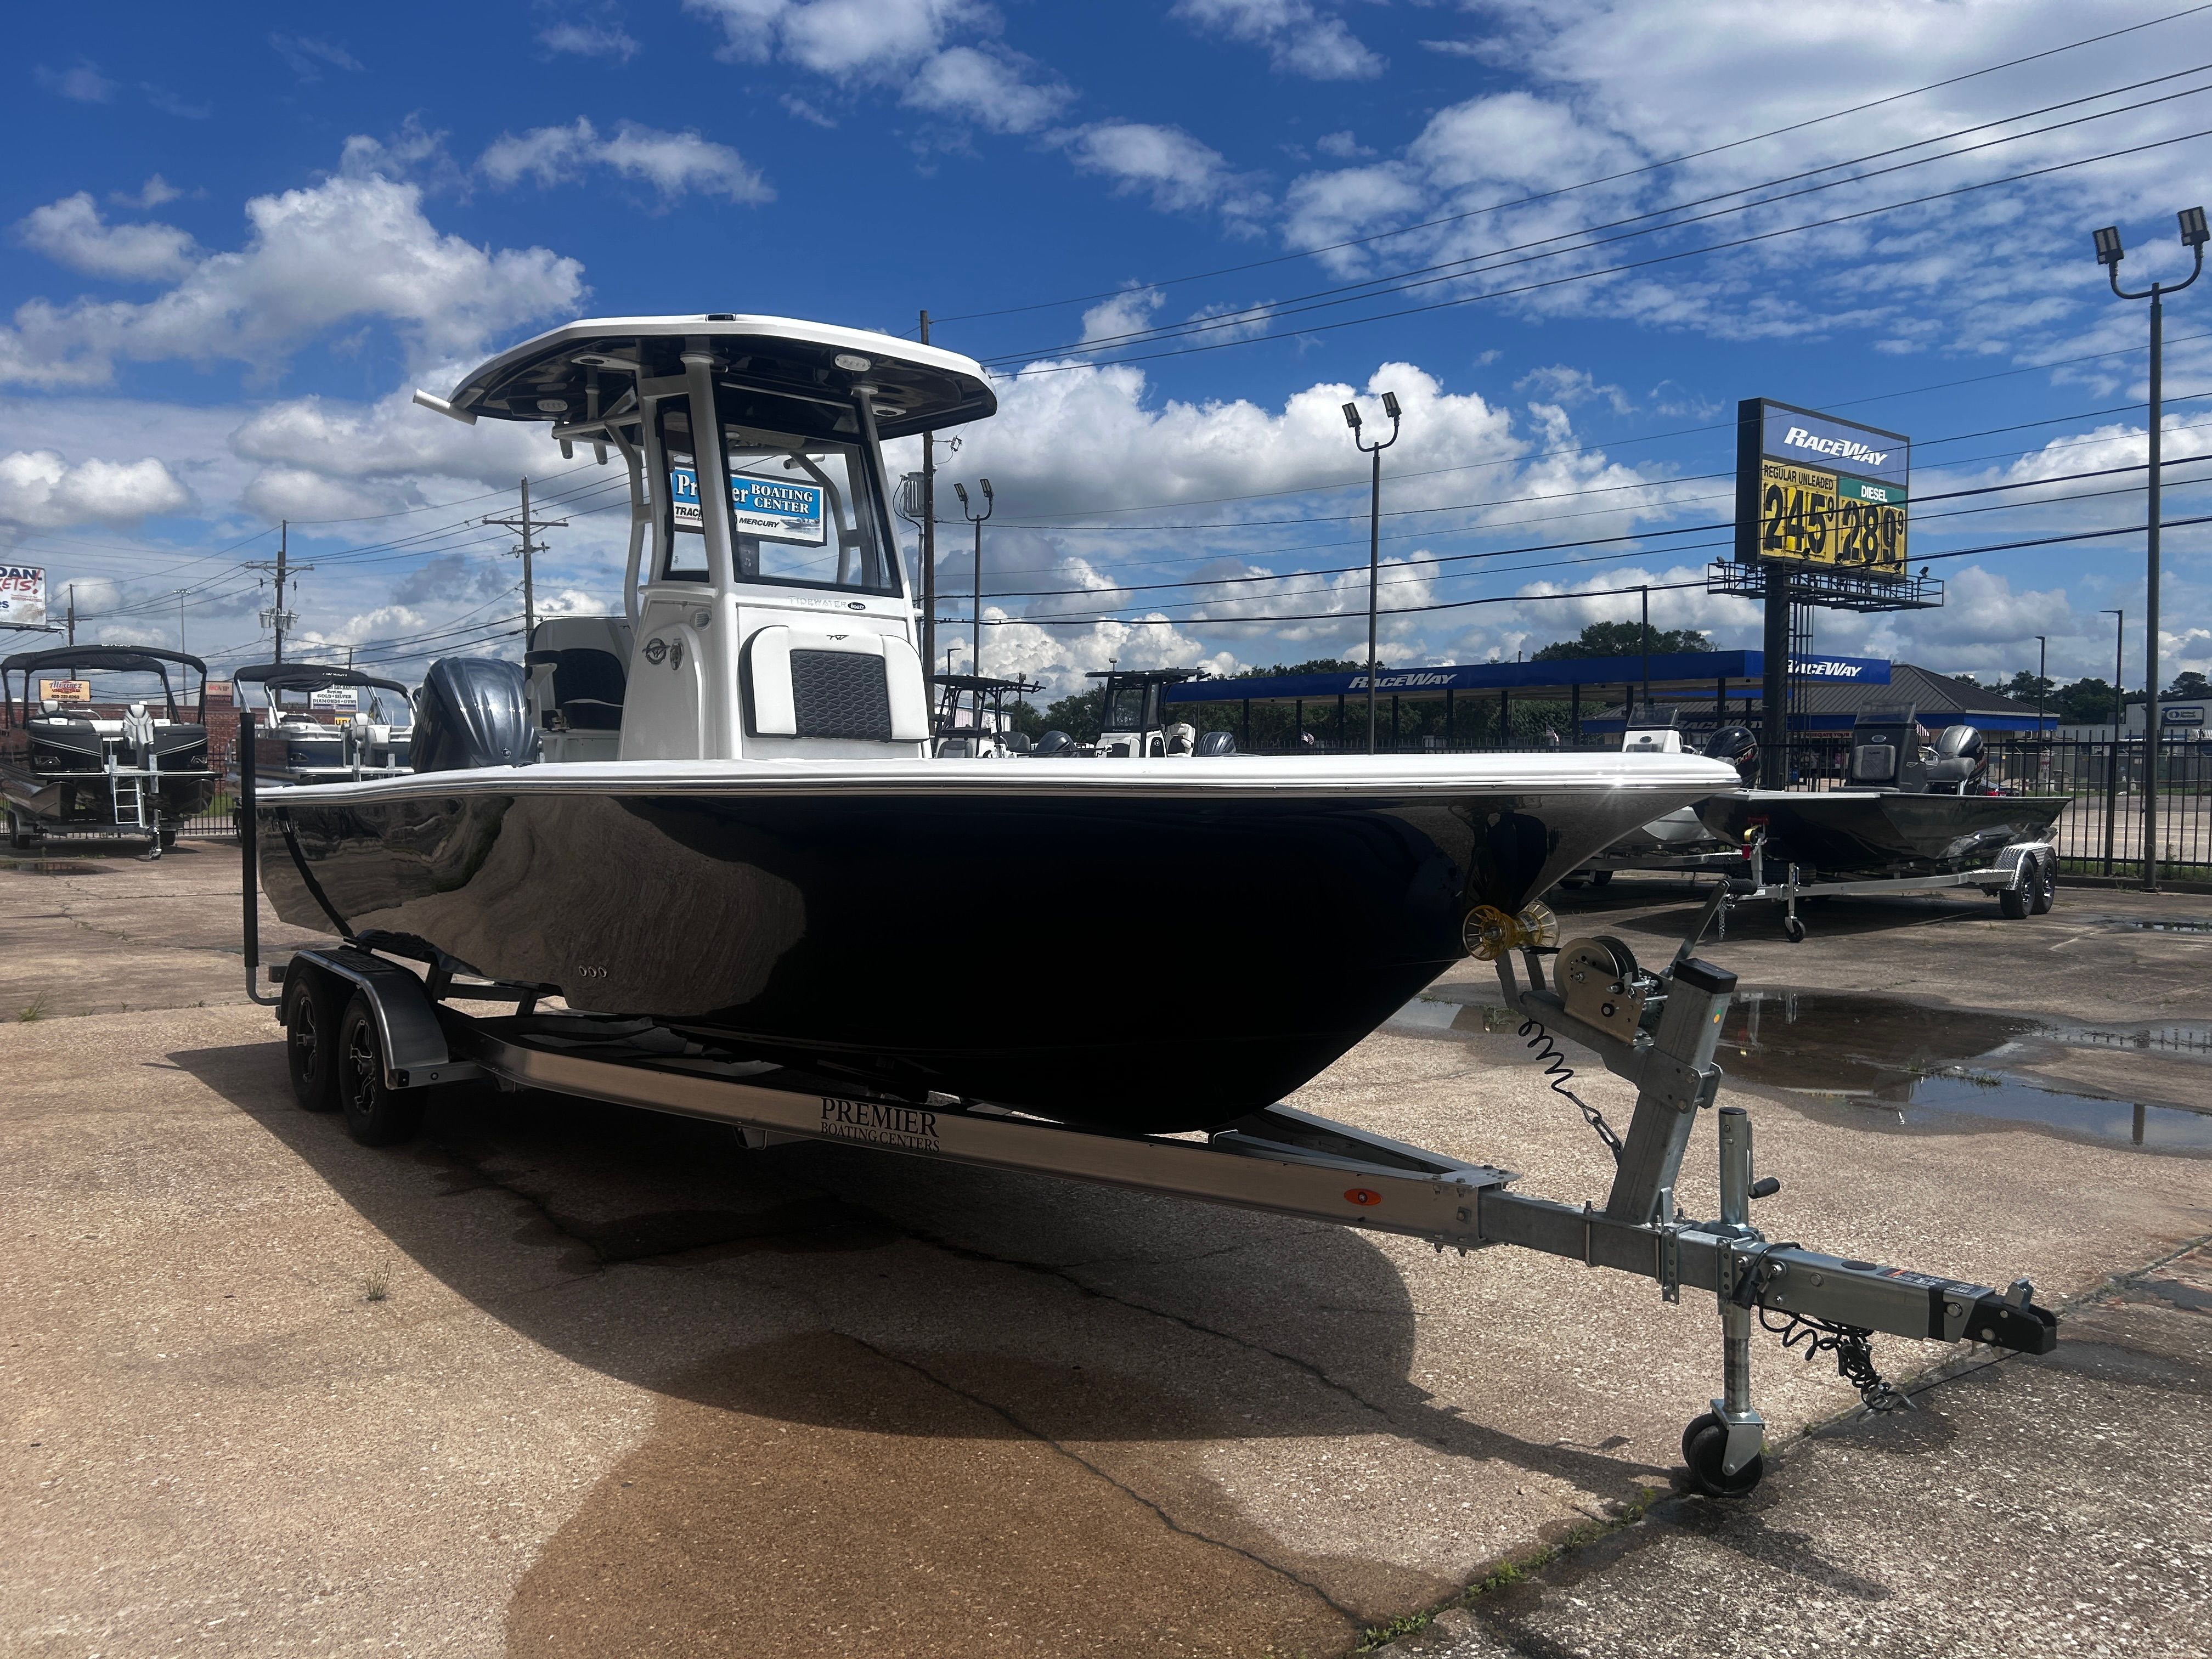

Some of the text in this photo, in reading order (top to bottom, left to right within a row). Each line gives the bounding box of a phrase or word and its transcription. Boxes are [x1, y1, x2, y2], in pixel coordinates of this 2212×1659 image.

[676, 474, 813, 503] Prer BOATING
[1764, 465, 1833, 490] REGULAR UNLEADED
[1861, 485, 1888, 503] DIESEL
[754, 496, 810, 515] CENTER
[738, 517, 780, 528] MERCURY
[788, 596, 847, 608] TIDEWATER
[820, 1097, 940, 1138] PREMIER
[820, 1121, 940, 1153] BOATING CENTERS
